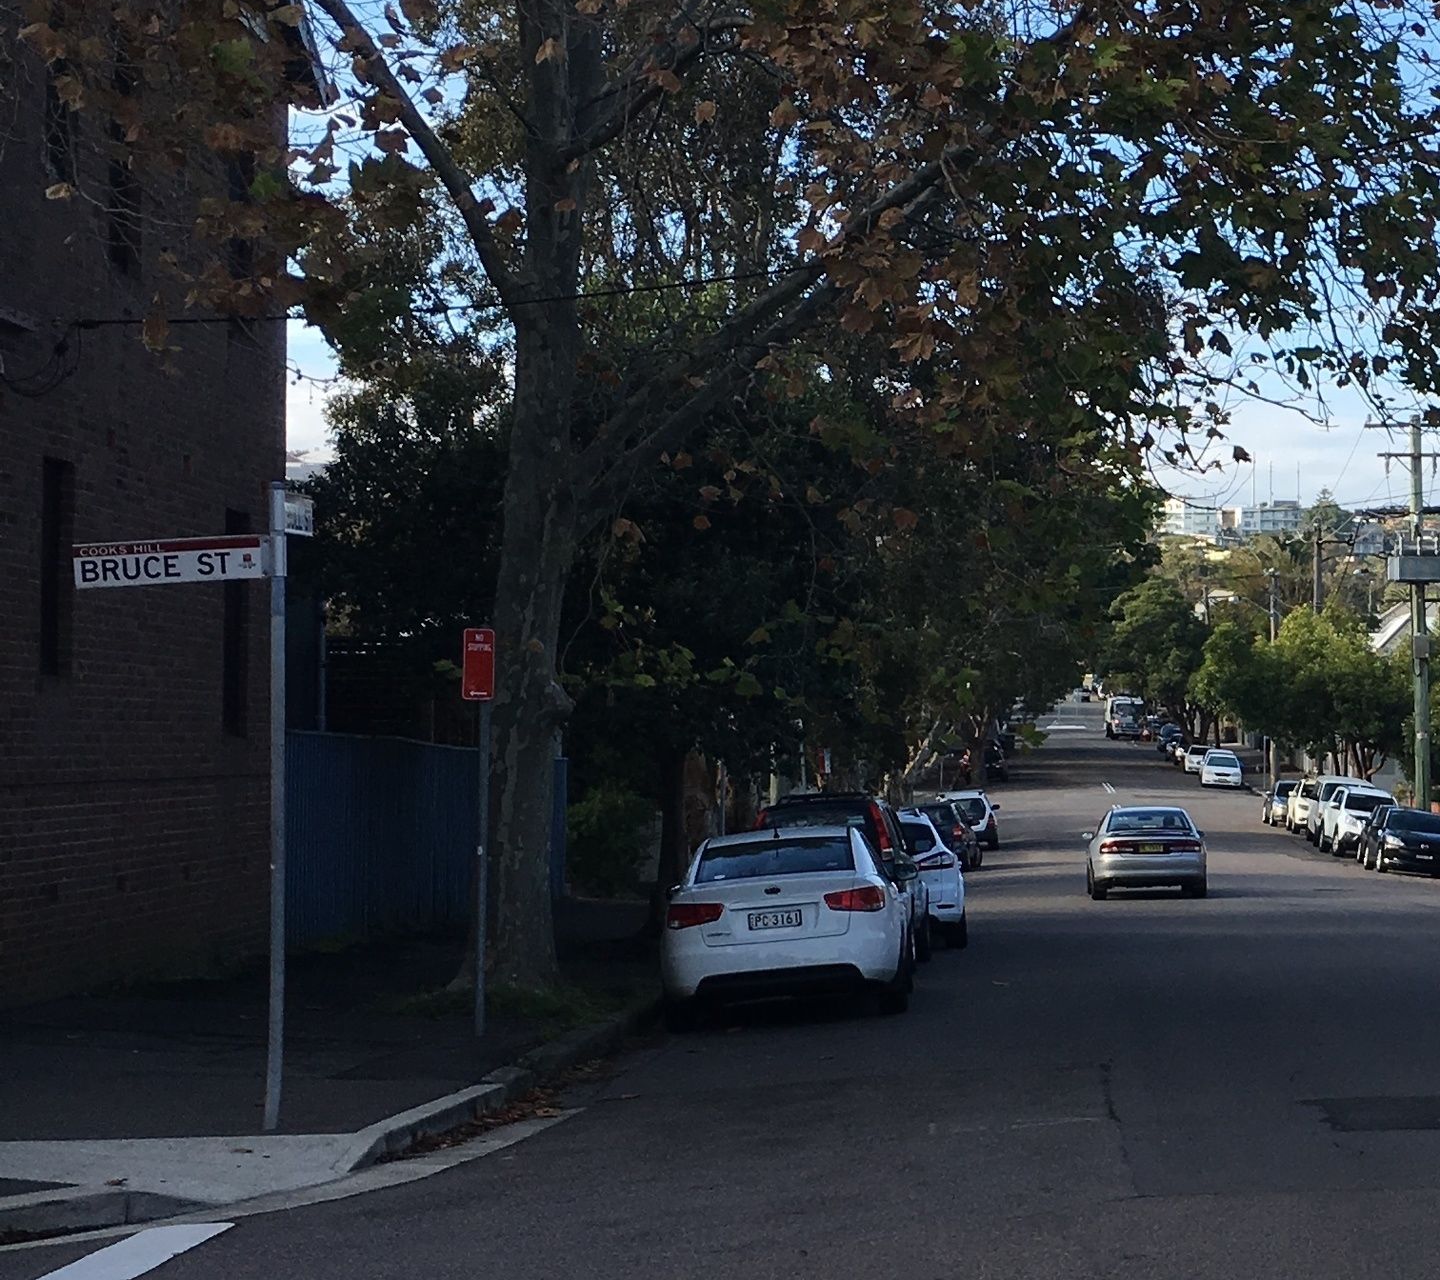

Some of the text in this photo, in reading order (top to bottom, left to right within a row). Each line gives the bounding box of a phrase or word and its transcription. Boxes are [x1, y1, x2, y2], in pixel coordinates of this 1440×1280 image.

[79, 543, 165, 558] COOKS HILL
[80, 551, 231, 583] BRUCE ST
[772, 912, 799, 926] 3161
